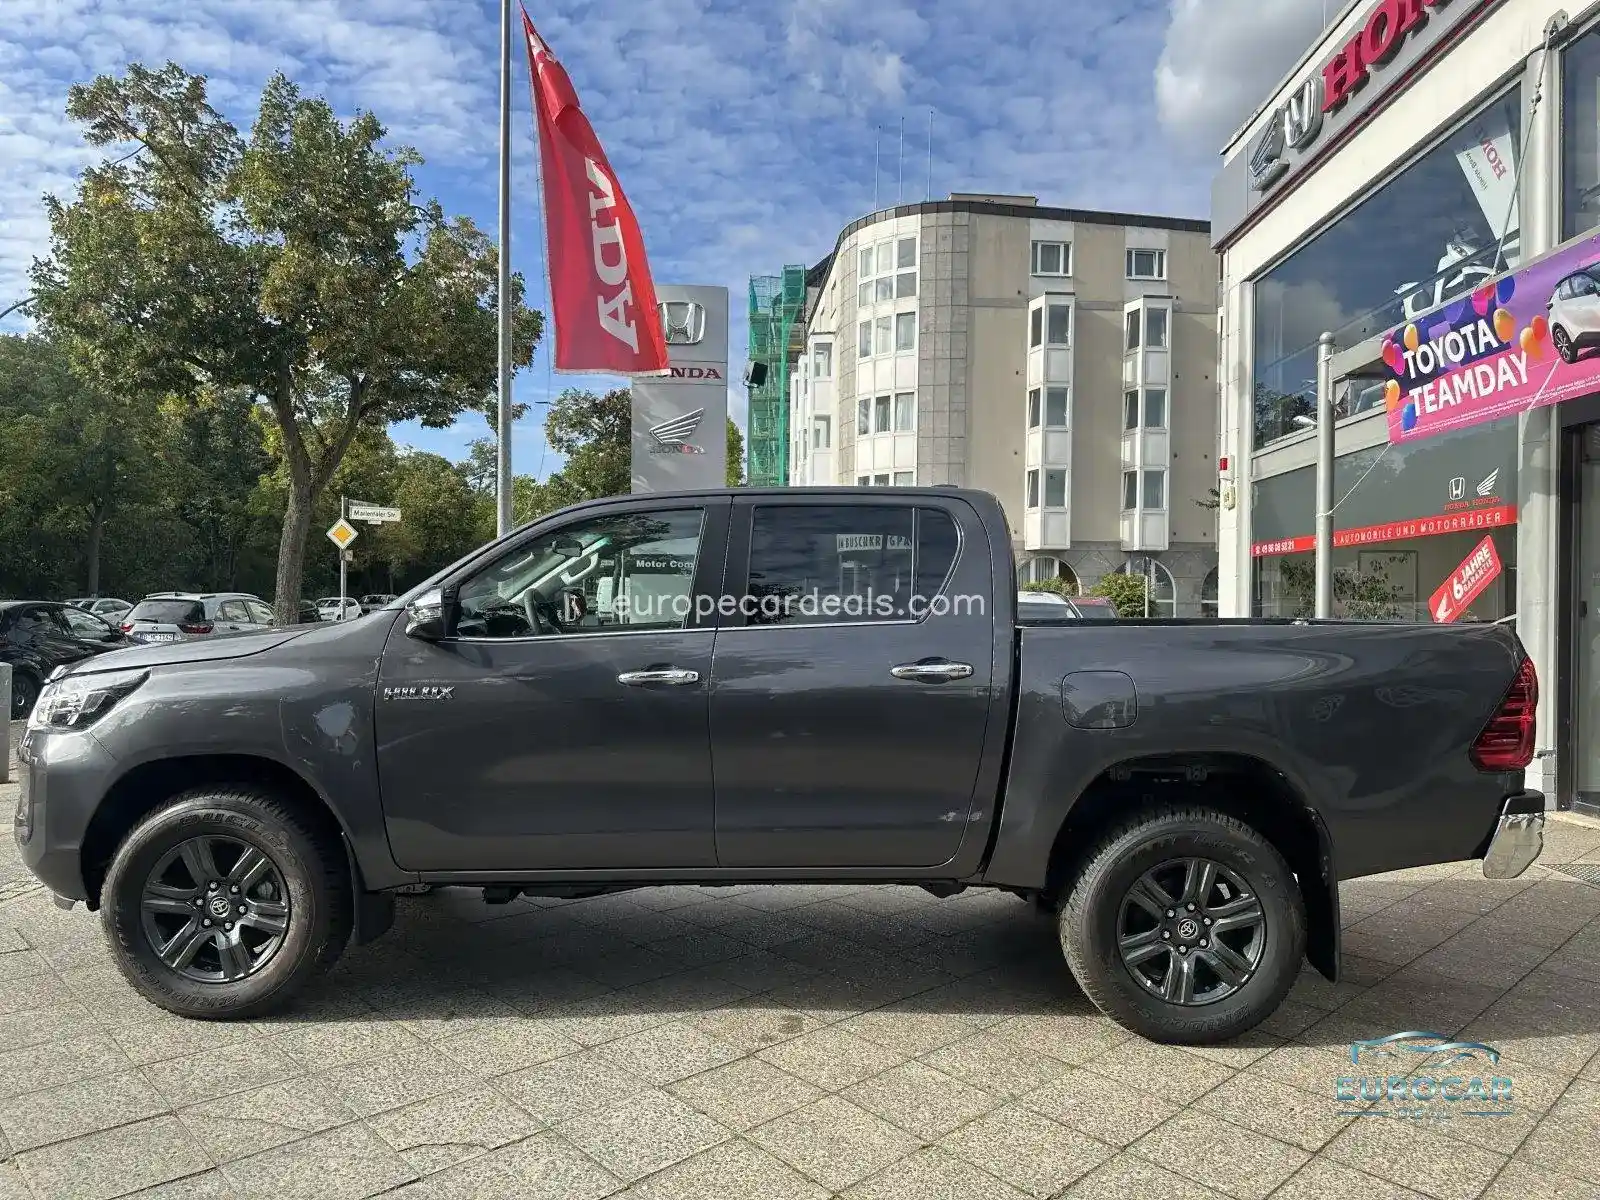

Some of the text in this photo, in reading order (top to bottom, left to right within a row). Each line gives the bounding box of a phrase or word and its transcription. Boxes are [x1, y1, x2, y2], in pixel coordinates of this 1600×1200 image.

[1402, 318, 1499, 379] TOYOTA
[669, 367, 722, 379] NDA
[1409, 350, 1529, 417] TEAMDAY
[1340, 528, 1391, 544] AUTOMOBILE
[1396, 524, 1416, 537] UND
[1420, 512, 1502, 533] MOTORRÄDER
[636, 560, 667, 568] Motor
[1461, 543, 1491, 584] JAHRE
[1463, 558, 1494, 593] GARANTIE
[1452, 575, 1464, 601] 6
